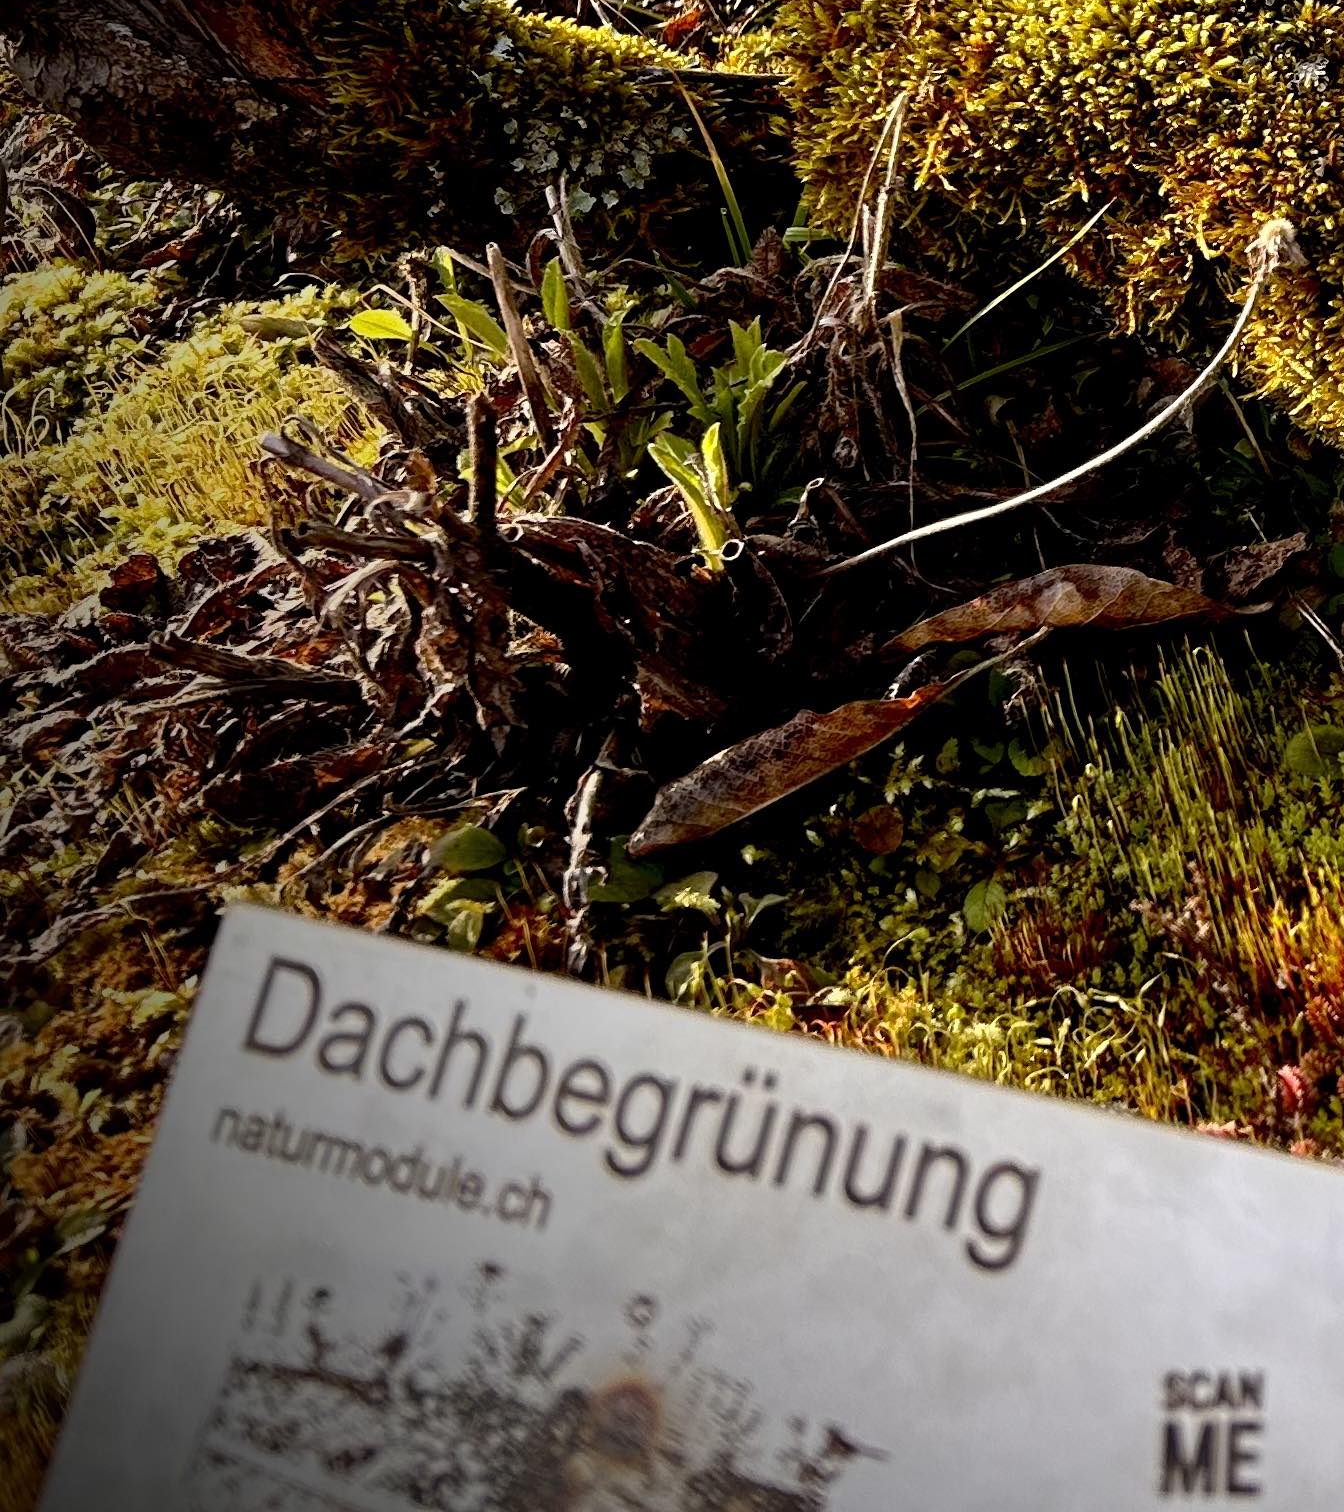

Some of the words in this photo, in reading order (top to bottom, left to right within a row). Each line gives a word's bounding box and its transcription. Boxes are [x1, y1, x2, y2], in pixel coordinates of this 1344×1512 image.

[242, 955, 1041, 1270] Dachbegrünung
[211, 1104, 553, 1231] naturmodule.ch
[1163, 1369, 1263, 1410] SCAN
[1159, 1421, 1263, 1495] ME
